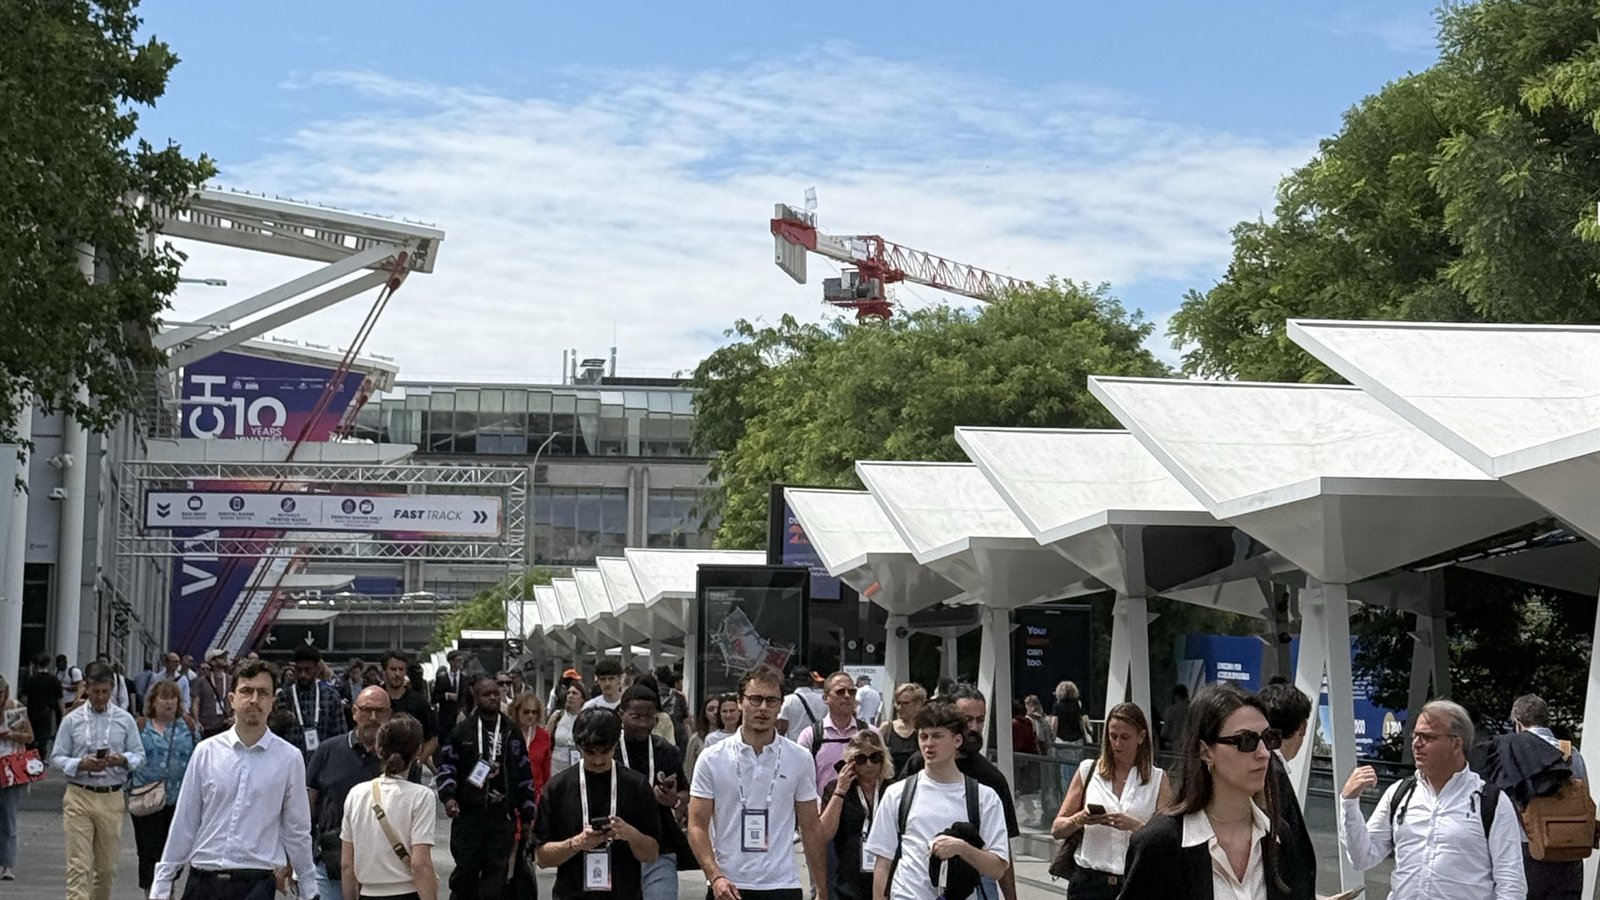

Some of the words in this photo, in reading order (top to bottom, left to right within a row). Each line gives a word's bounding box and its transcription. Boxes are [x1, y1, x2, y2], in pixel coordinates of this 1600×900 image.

[231, 396, 287, 436] 10
[251, 427, 283, 436] YEARS
[394, 509, 425, 519] FAST
[427, 510, 463, 520] TRACK
[1026, 626, 1047, 635] Your
